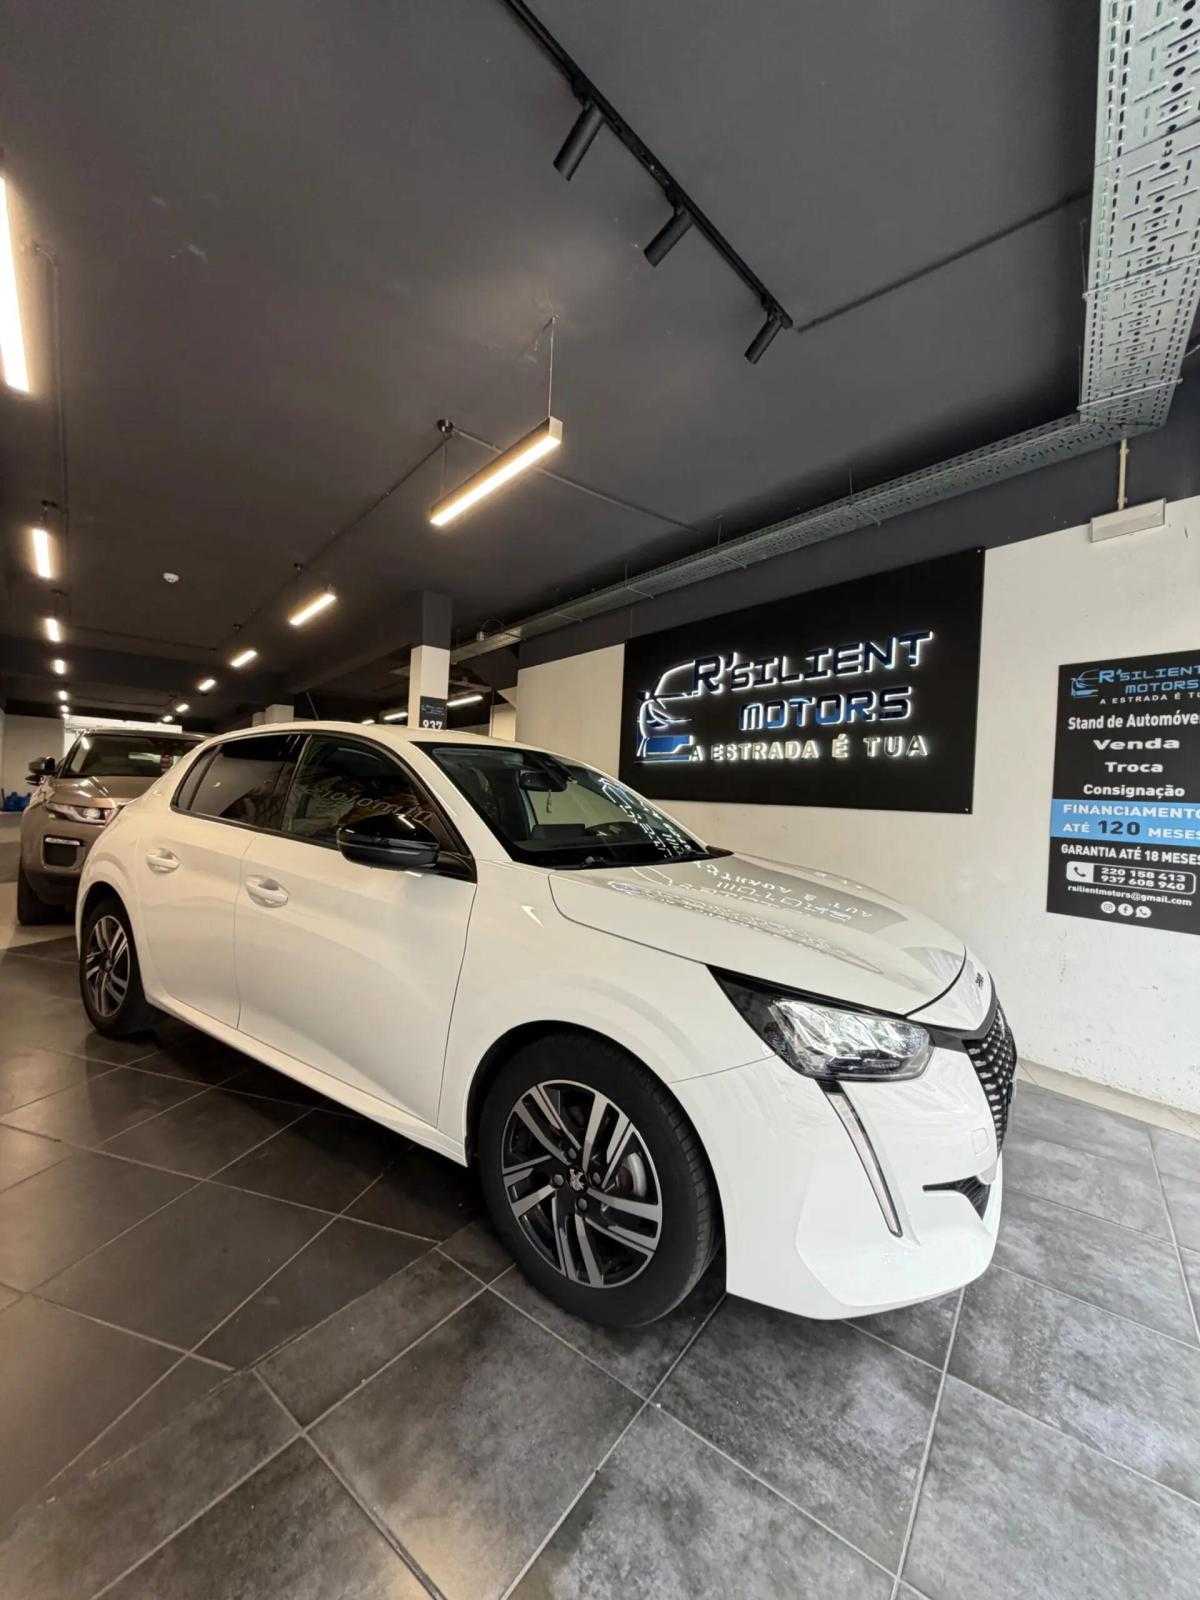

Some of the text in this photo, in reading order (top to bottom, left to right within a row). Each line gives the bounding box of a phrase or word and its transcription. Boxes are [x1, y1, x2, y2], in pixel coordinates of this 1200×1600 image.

[1125, 679, 1199, 694] MOTORS
[1112, 694, 1168, 704] ESTRADA
[739, 686, 913, 731] MOTORS
[1068, 709, 1200, 730] Stand de Automóve
[688, 733, 928, 762] A ESTRADA É TUA
[1093, 737, 1180, 750] Venda
[1105, 761, 1163, 773] Troca
[1083, 784, 1186, 799] Consignação
[1062, 822, 1090, 833] ATÉ
[1098, 820, 1141, 835] 120
[1061, 843, 1117, 858] GARANTIA
[1118, 846, 1142, 860] ATÉ
[1144, 850, 1159, 862] 18
[1101, 867, 1126, 876] 220
[1158, 872, 1186, 882] 413
[1101, 875, 1186, 891] 937 608 940
[1067, 885, 1192, 906] rsilientmotors@gmail.com
